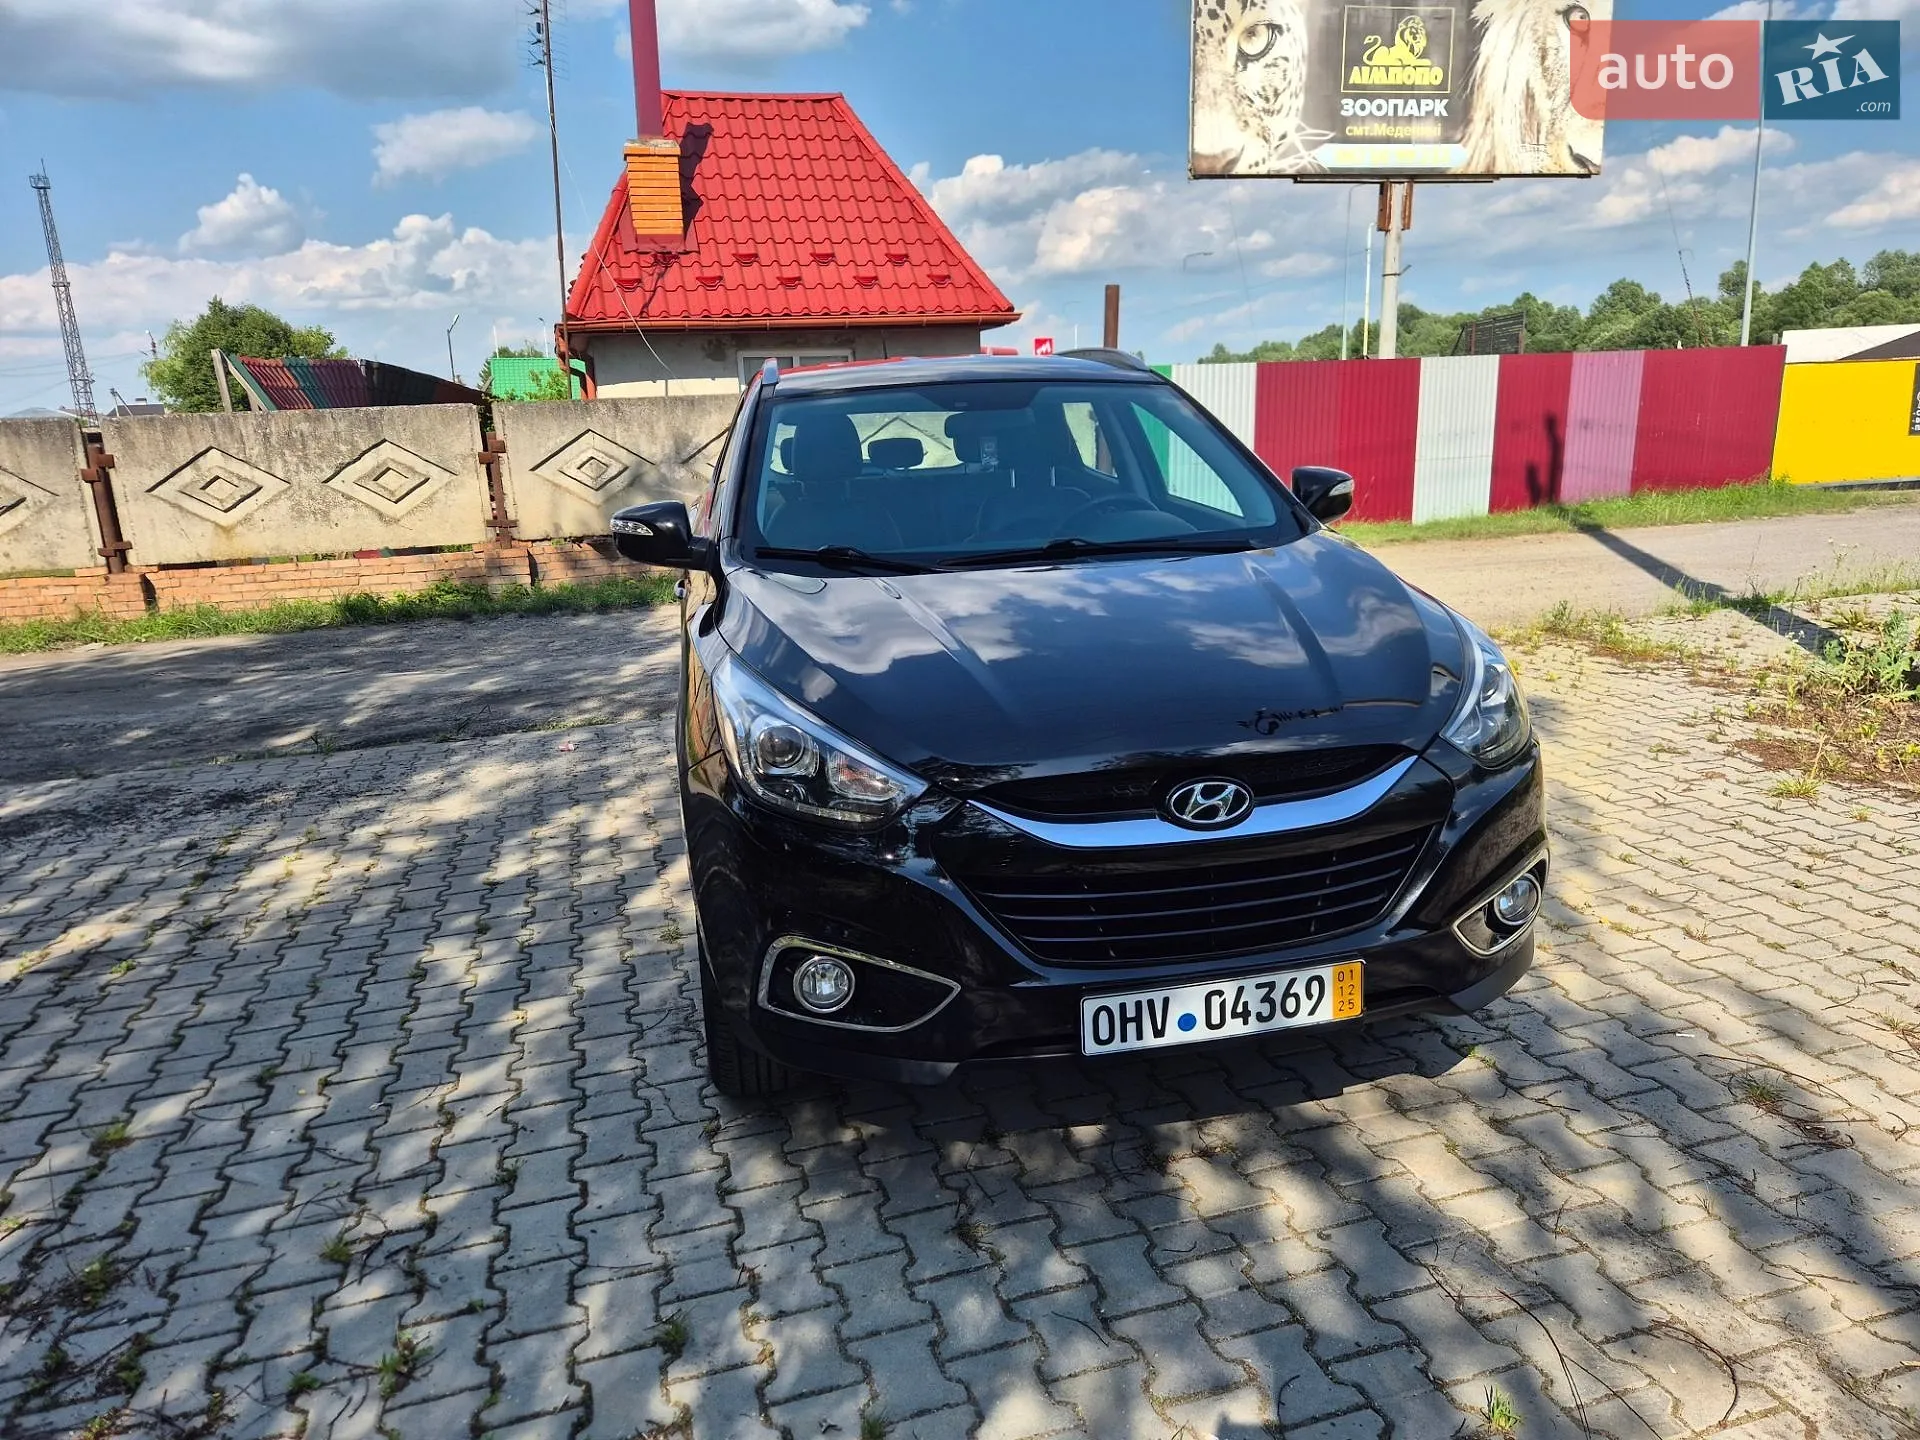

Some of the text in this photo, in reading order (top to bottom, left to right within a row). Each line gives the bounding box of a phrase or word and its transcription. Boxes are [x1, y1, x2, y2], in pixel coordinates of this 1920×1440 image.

[1340, 98, 1449, 117] ЗООПАРК
[1337, 969, 1355, 982] 01
[1339, 984, 1355, 997] 12
[1092, 974, 1326, 1046] OHV 04369
[1338, 998, 1355, 1012] 25
